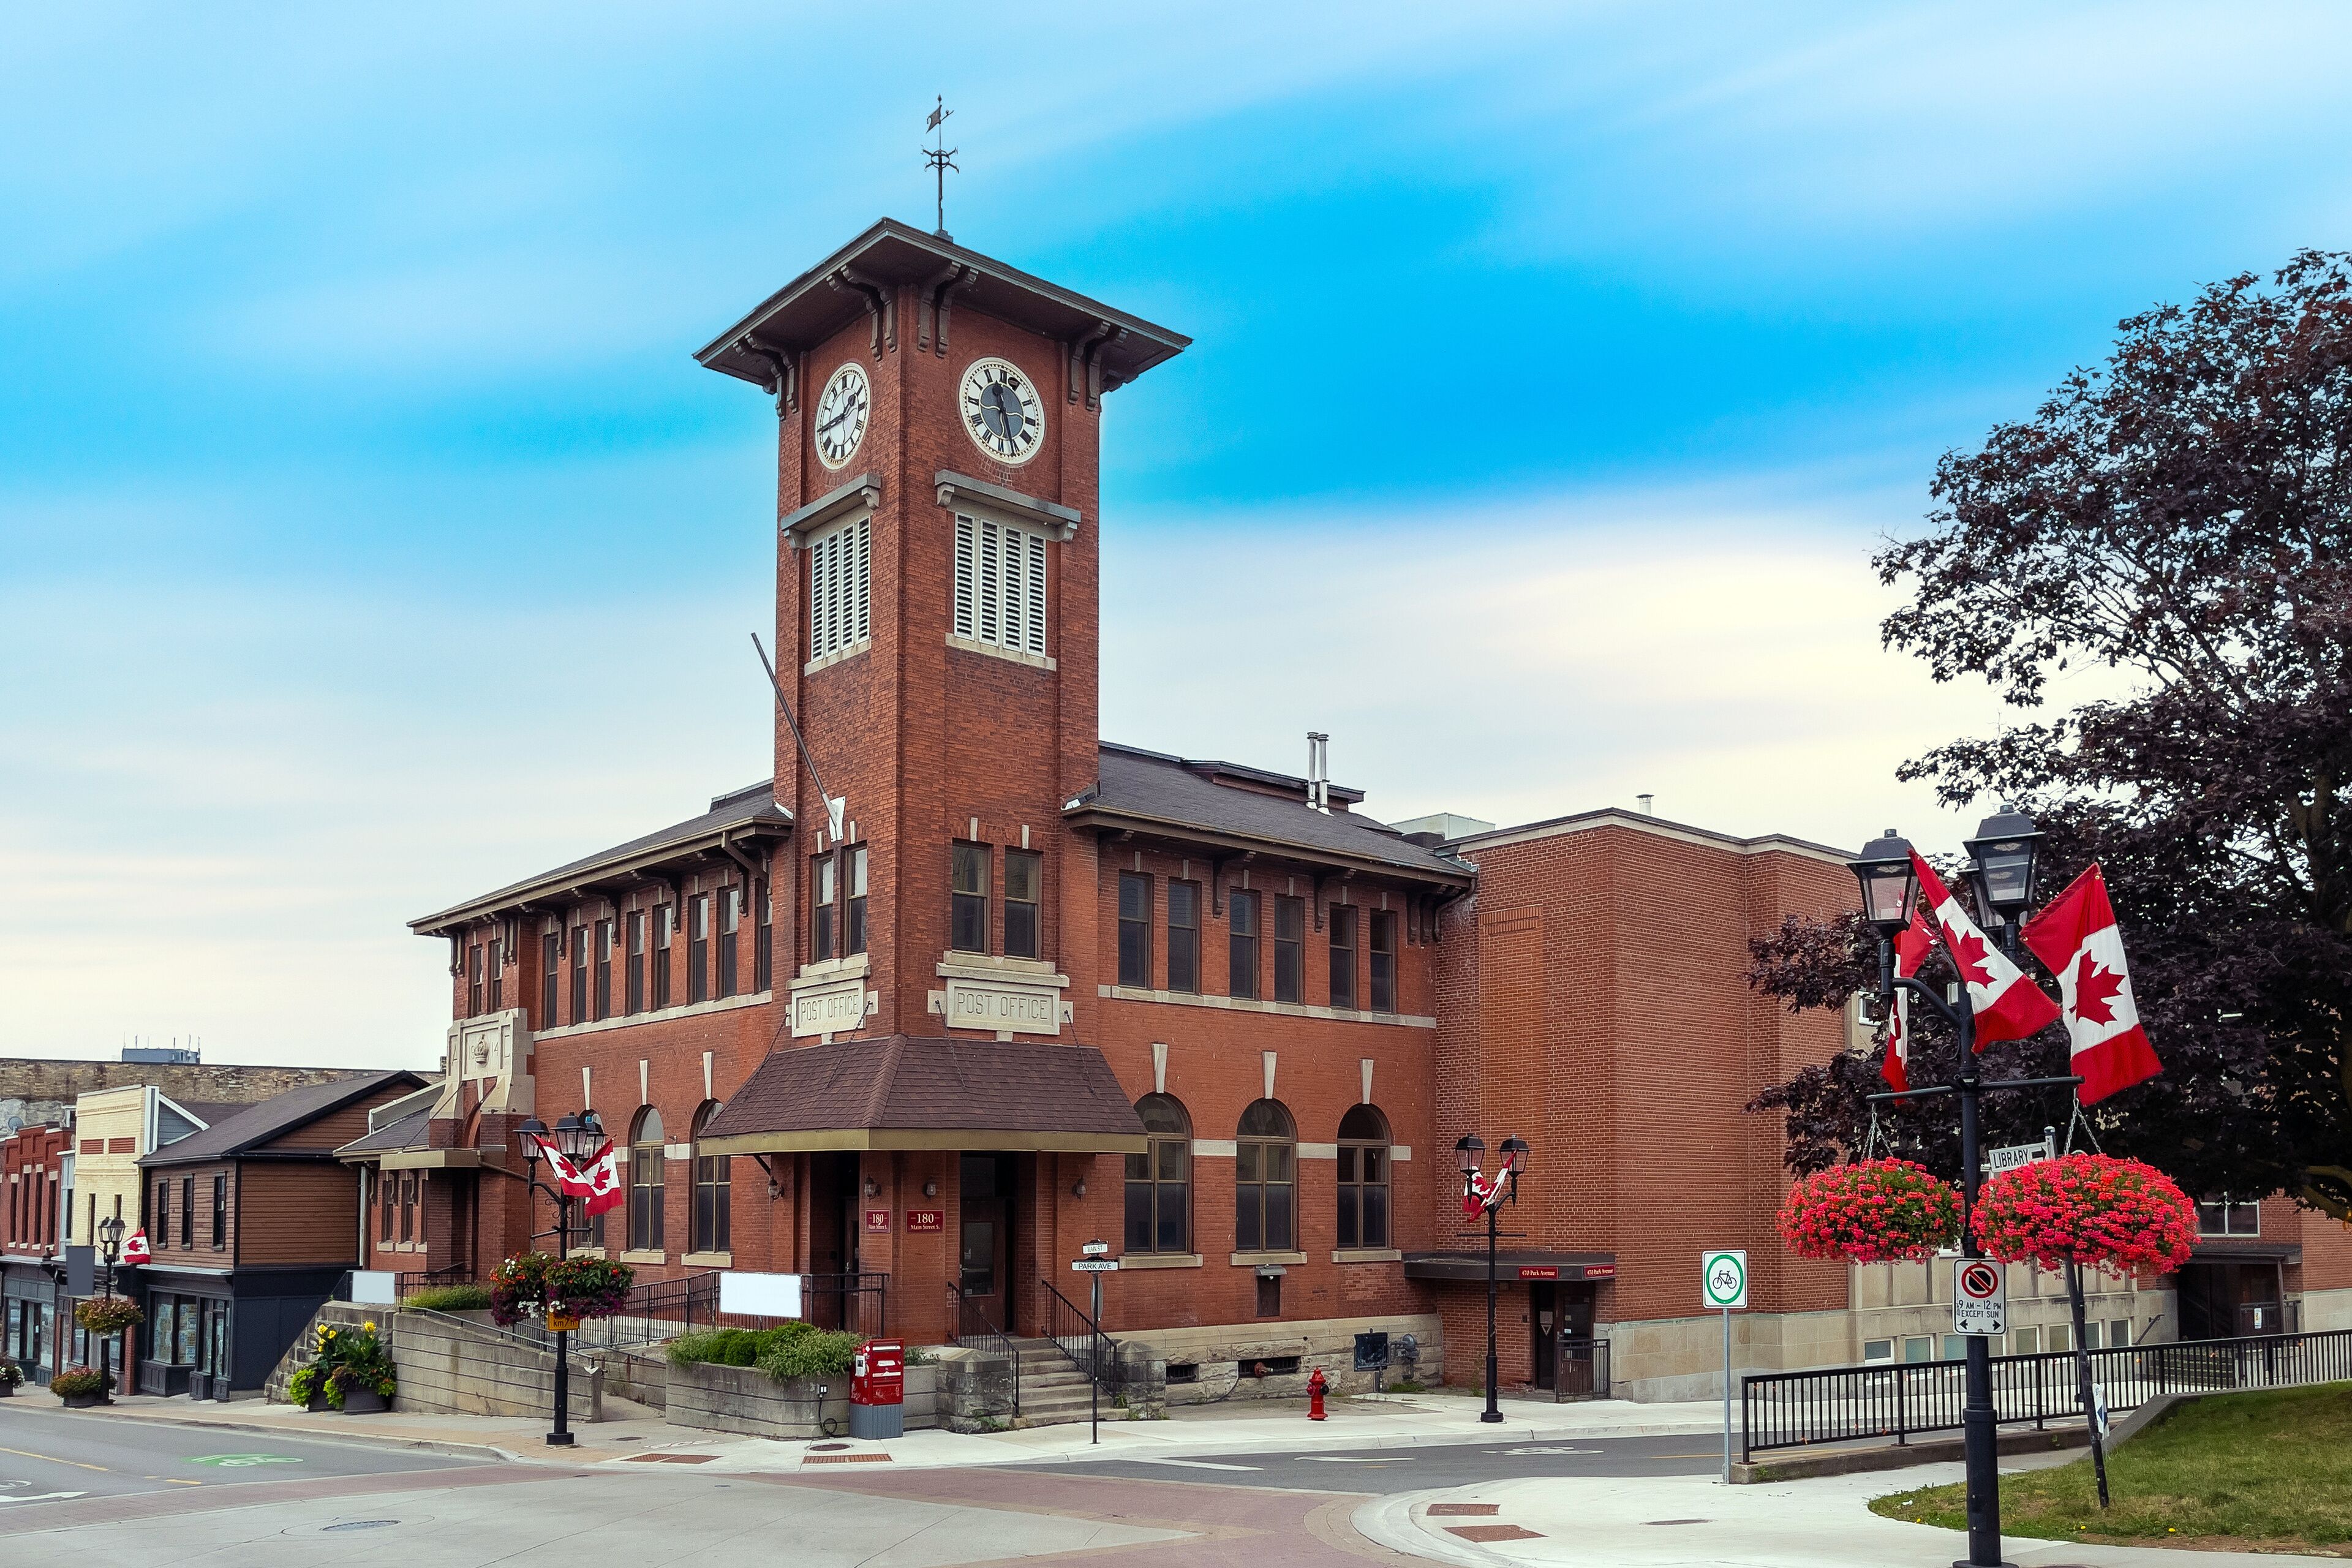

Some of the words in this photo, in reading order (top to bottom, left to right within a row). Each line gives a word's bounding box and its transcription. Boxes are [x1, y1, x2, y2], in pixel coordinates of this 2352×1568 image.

[801, 1000, 823, 1022] POST
[827, 995, 859, 1017] OFFICE
[957, 992, 992, 1015] POST
[1000, 997, 1047, 1019] OFFICE
[1993, 1148, 2029, 1169] LIBRARY
[872, 1213, 884, 1224] 180
[917, 1213, 934, 1224] 180
[1959, 1299, 1964, 1309] 9
[1983, 1300, 1991, 1310] 12
